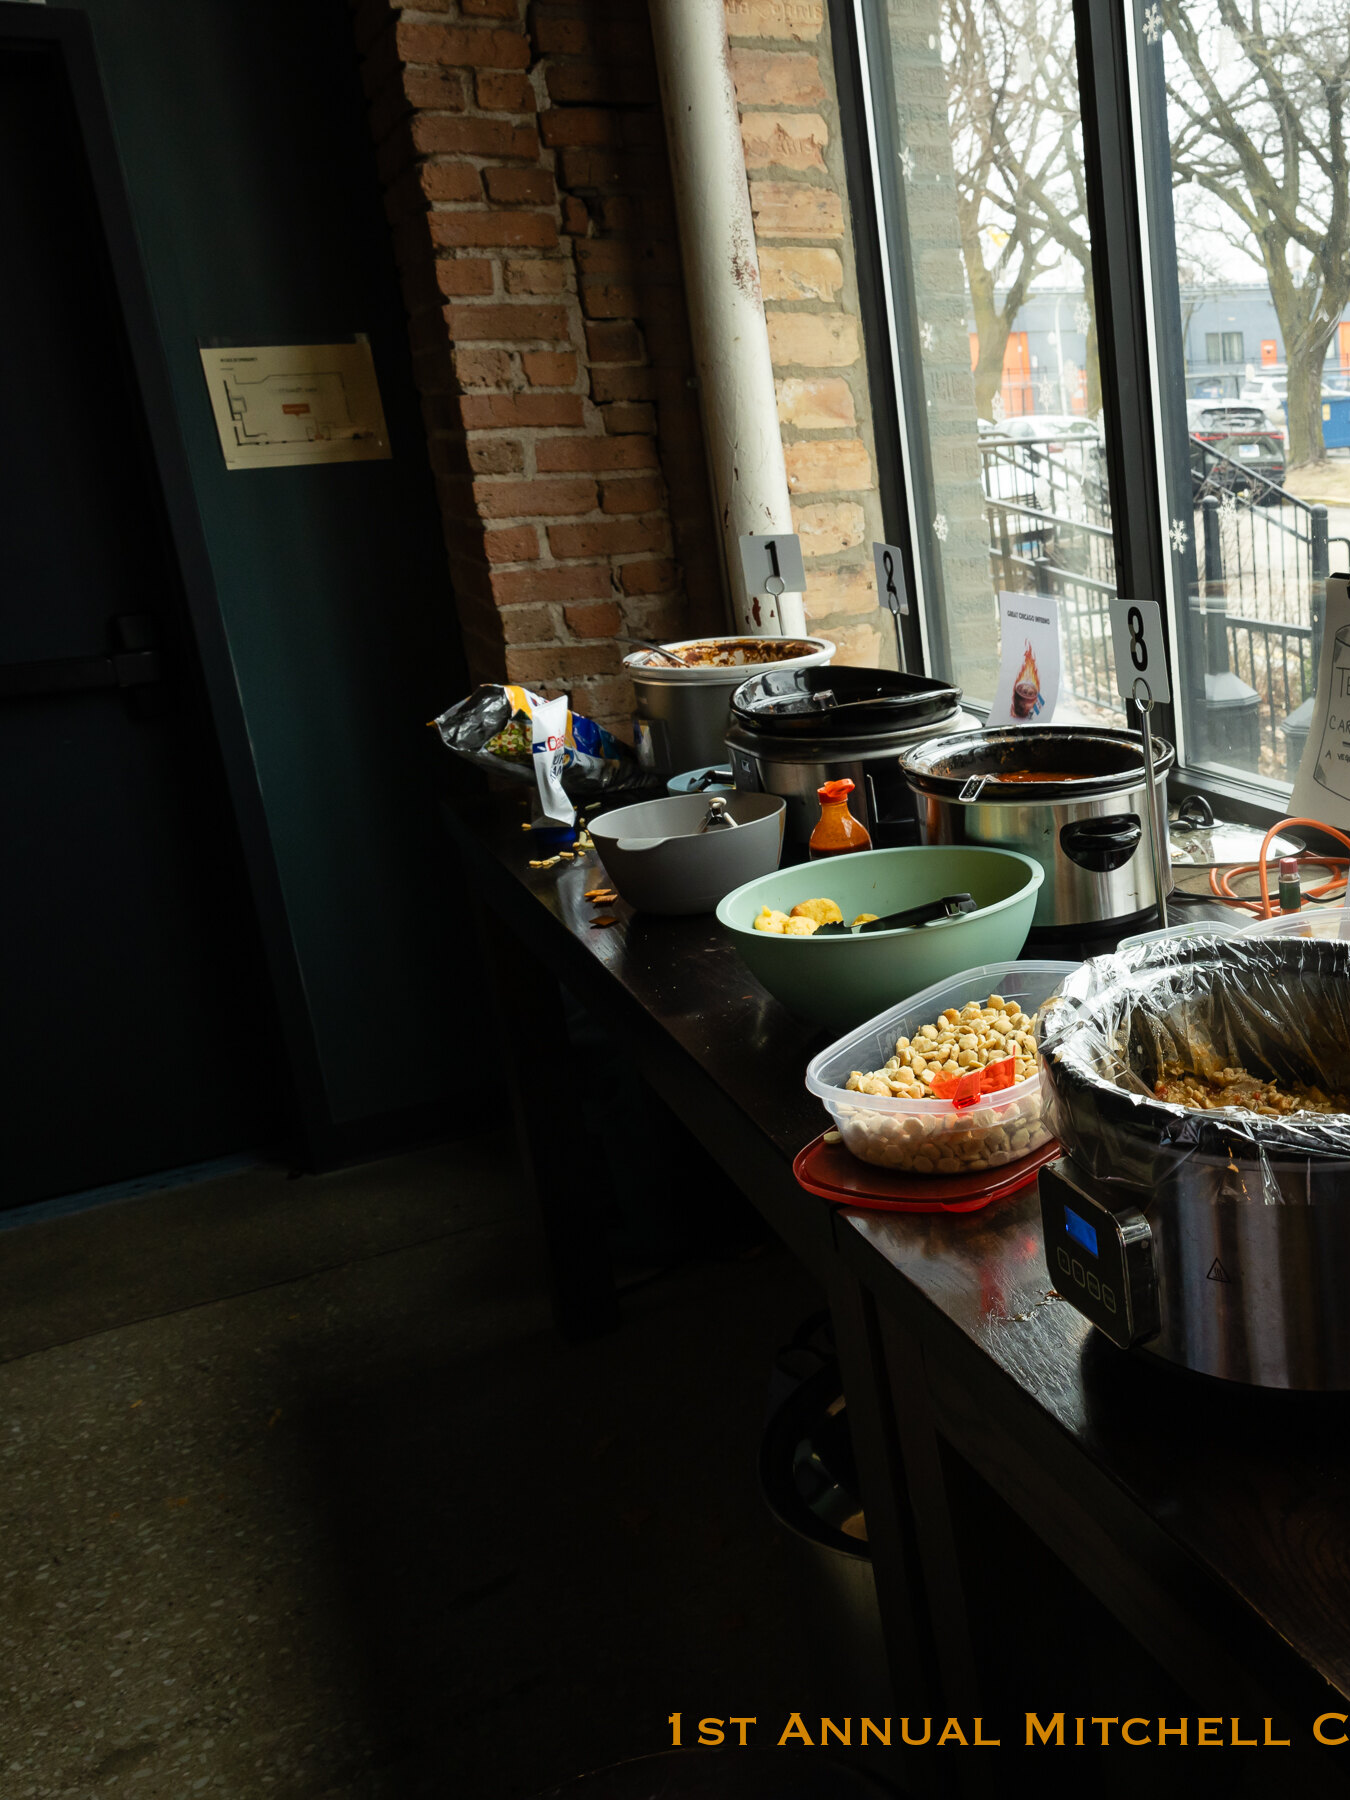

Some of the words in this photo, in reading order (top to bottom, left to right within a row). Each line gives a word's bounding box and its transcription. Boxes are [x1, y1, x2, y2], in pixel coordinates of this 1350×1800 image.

[764, 540, 781, 578] 1
[883, 550, 897, 595] 2
[1127, 606, 1148, 672] 8
[1325, 750, 1332, 760] A
